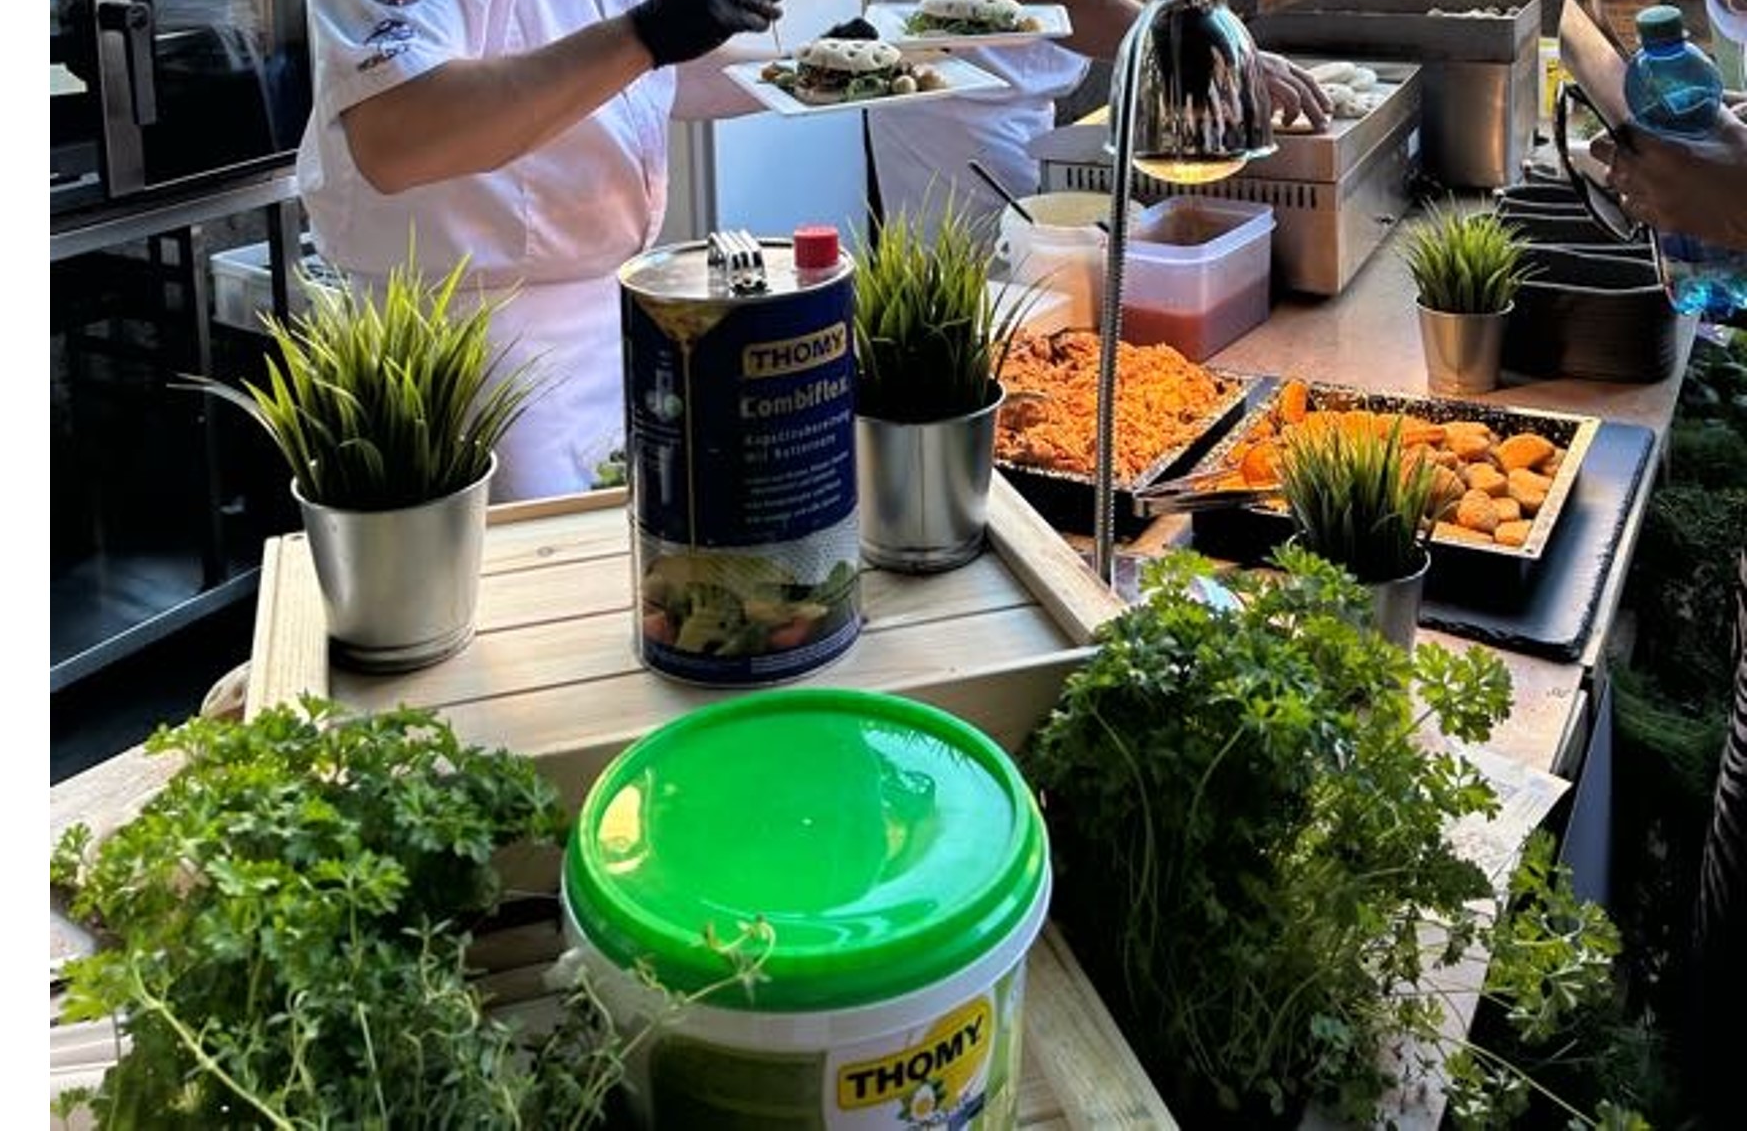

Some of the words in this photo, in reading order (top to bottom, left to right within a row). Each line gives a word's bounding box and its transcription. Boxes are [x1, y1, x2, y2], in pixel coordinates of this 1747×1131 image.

[751, 327, 844, 370] THOMY
[740, 375, 850, 418] Combiflex
[845, 1013, 984, 1100] THOMY
